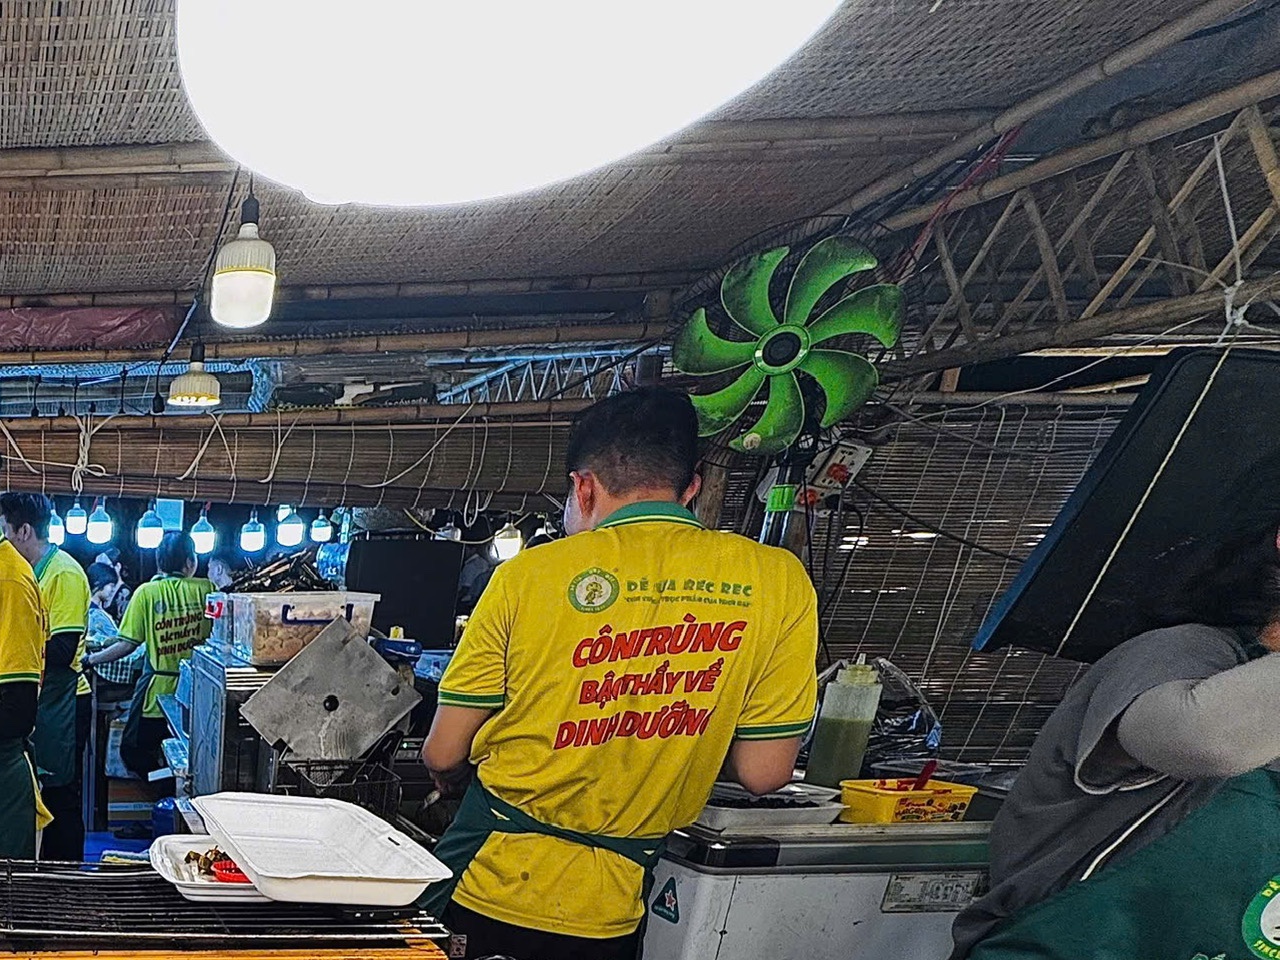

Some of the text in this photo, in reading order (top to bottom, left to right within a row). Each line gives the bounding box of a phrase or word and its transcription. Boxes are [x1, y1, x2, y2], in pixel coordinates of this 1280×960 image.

[683, 579, 714, 594] REC
[720, 582, 752, 597] REC
[572, 613, 747, 668] CÔN TRÙNG
[553, 707, 621, 750] DINH
